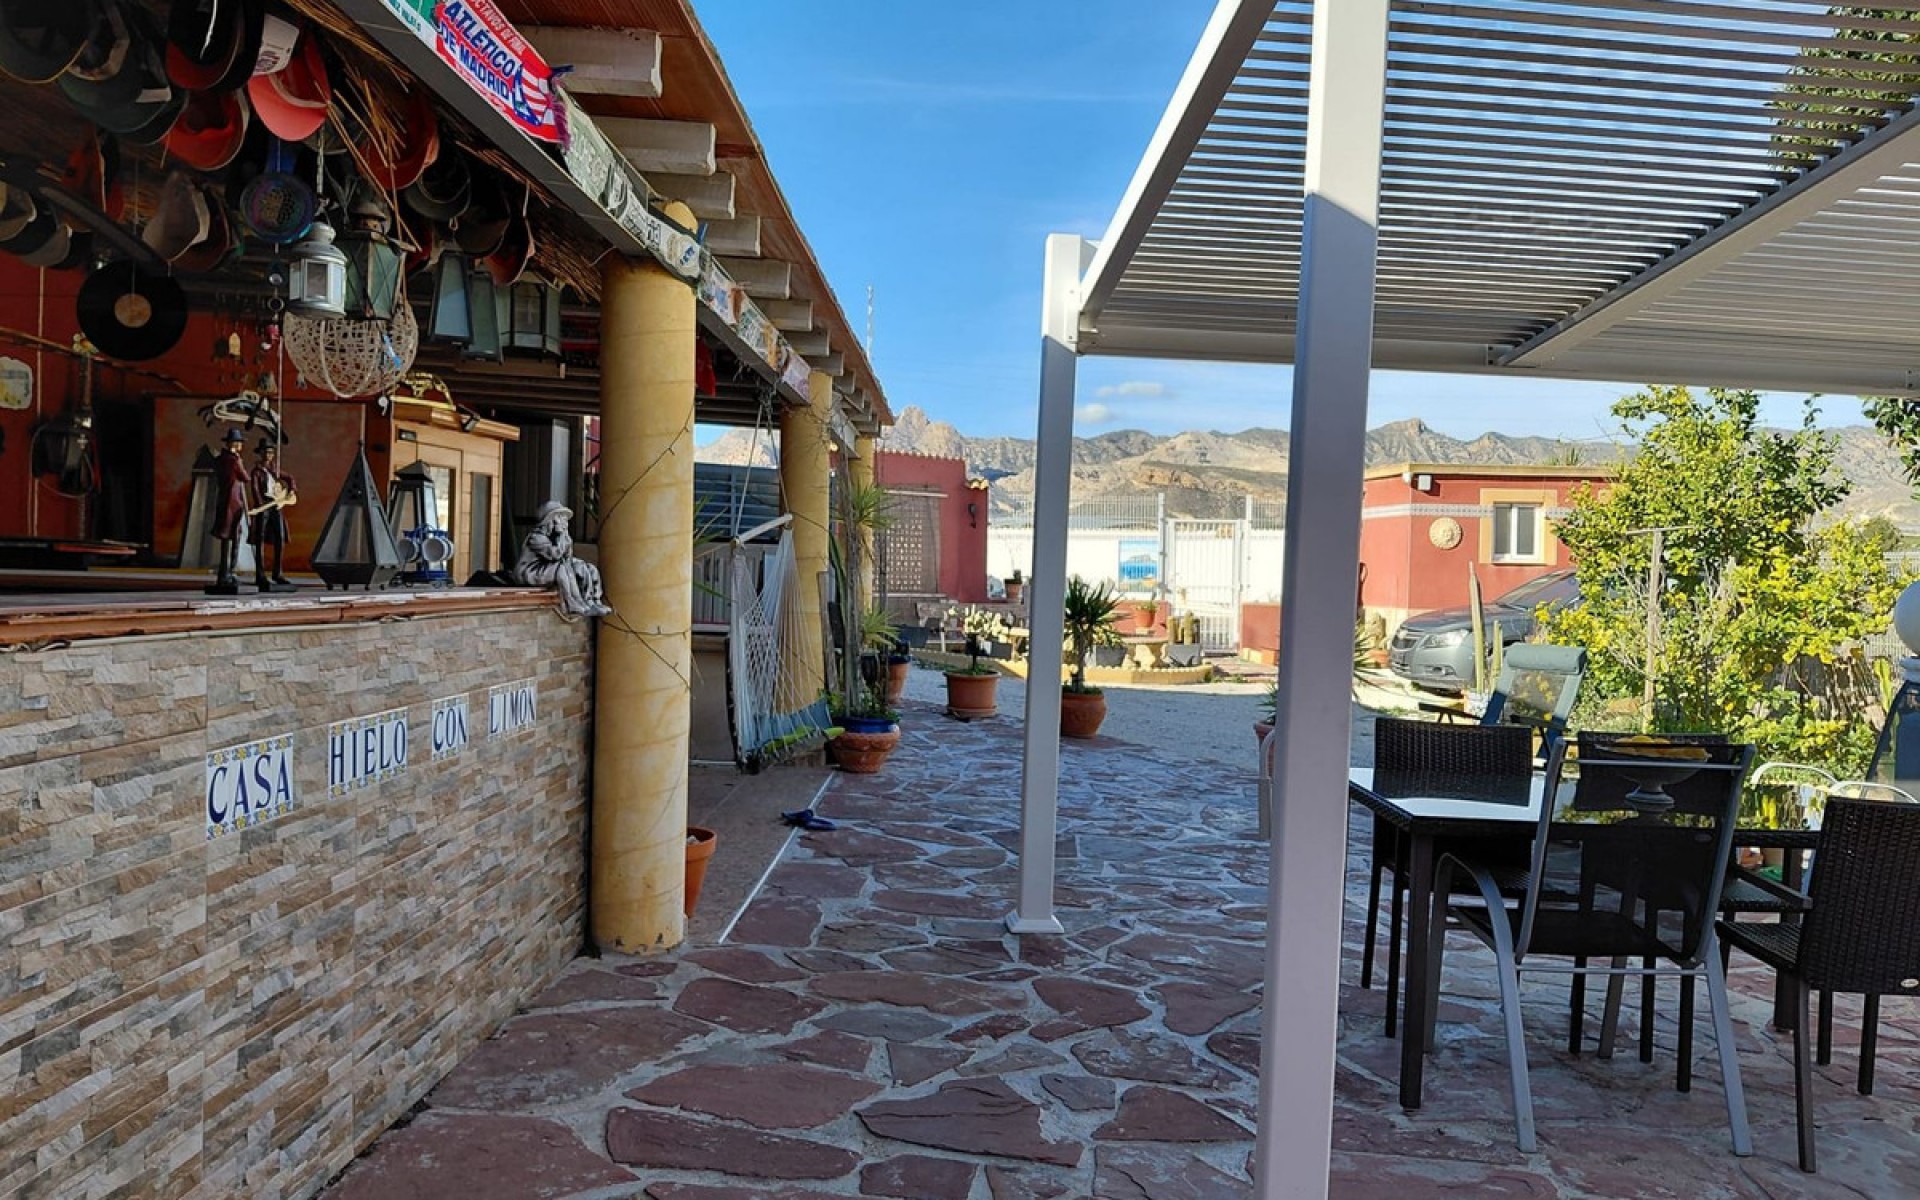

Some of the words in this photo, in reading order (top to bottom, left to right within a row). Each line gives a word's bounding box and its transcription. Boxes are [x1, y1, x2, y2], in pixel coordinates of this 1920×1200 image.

[439, 20, 457, 54] DE
[460, 43, 510, 100] MADRID
[444, 1, 516, 78] ATLÉTICO
[208, 751, 291, 824] CASA
[330, 720, 406, 785] HIELO
[433, 708, 467, 751] CON
